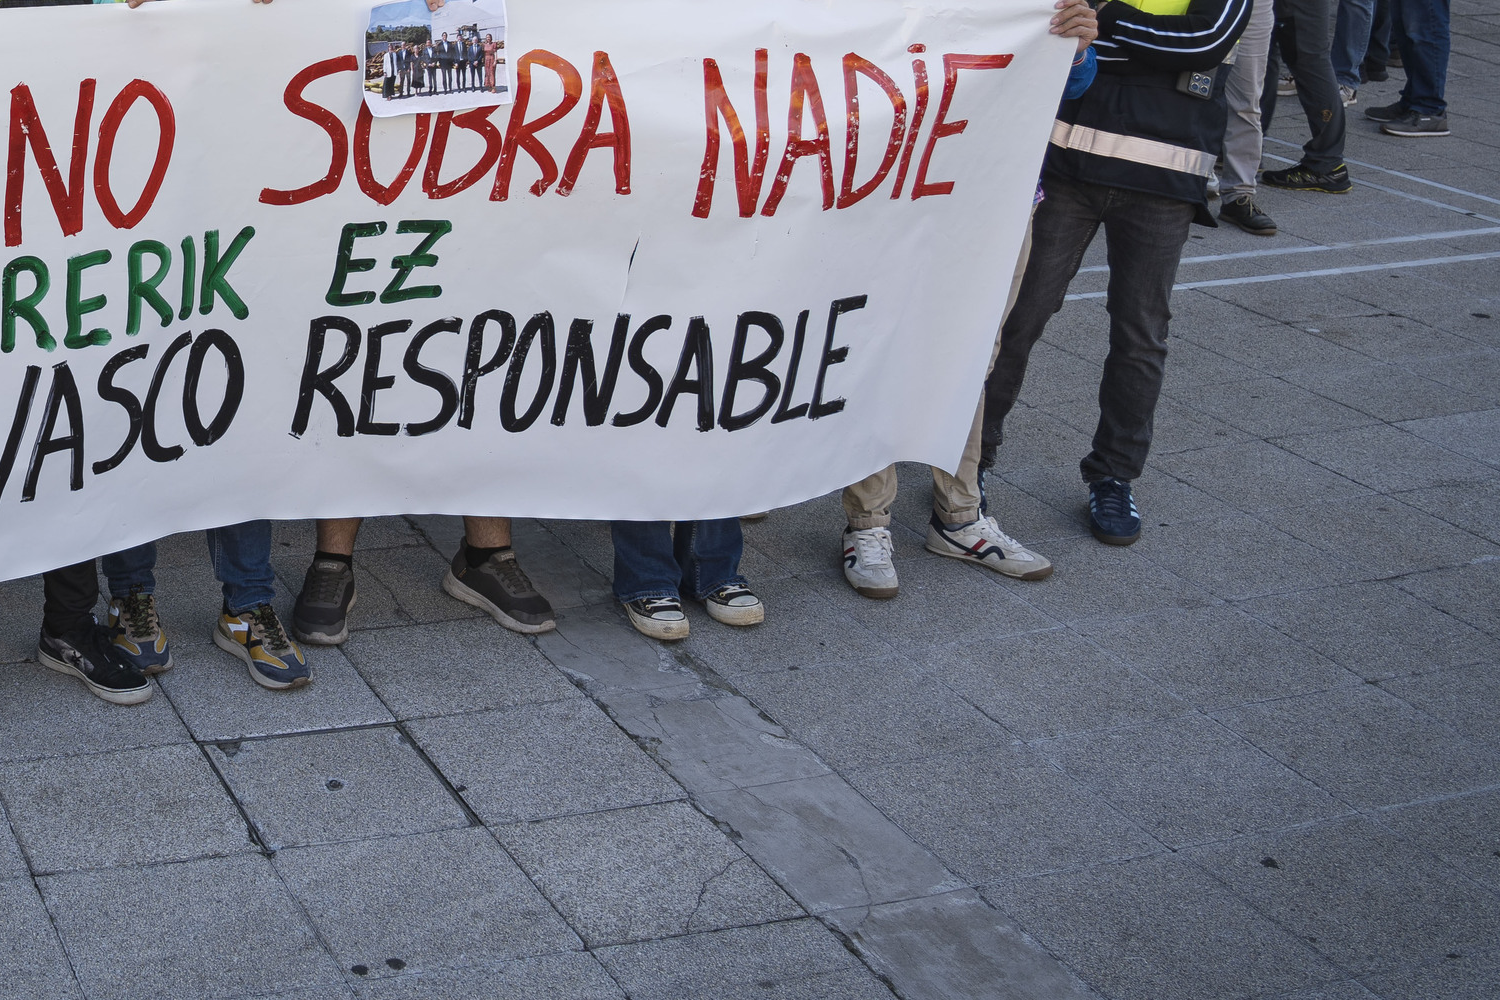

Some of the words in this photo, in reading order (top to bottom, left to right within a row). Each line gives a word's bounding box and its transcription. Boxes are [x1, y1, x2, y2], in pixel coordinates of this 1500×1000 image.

[3, 77, 177, 248] NO
[258, 49, 632, 207] SOBRA
[325, 219, 452, 307] EZ
[289, 294, 869, 439] RESPONSABLE
